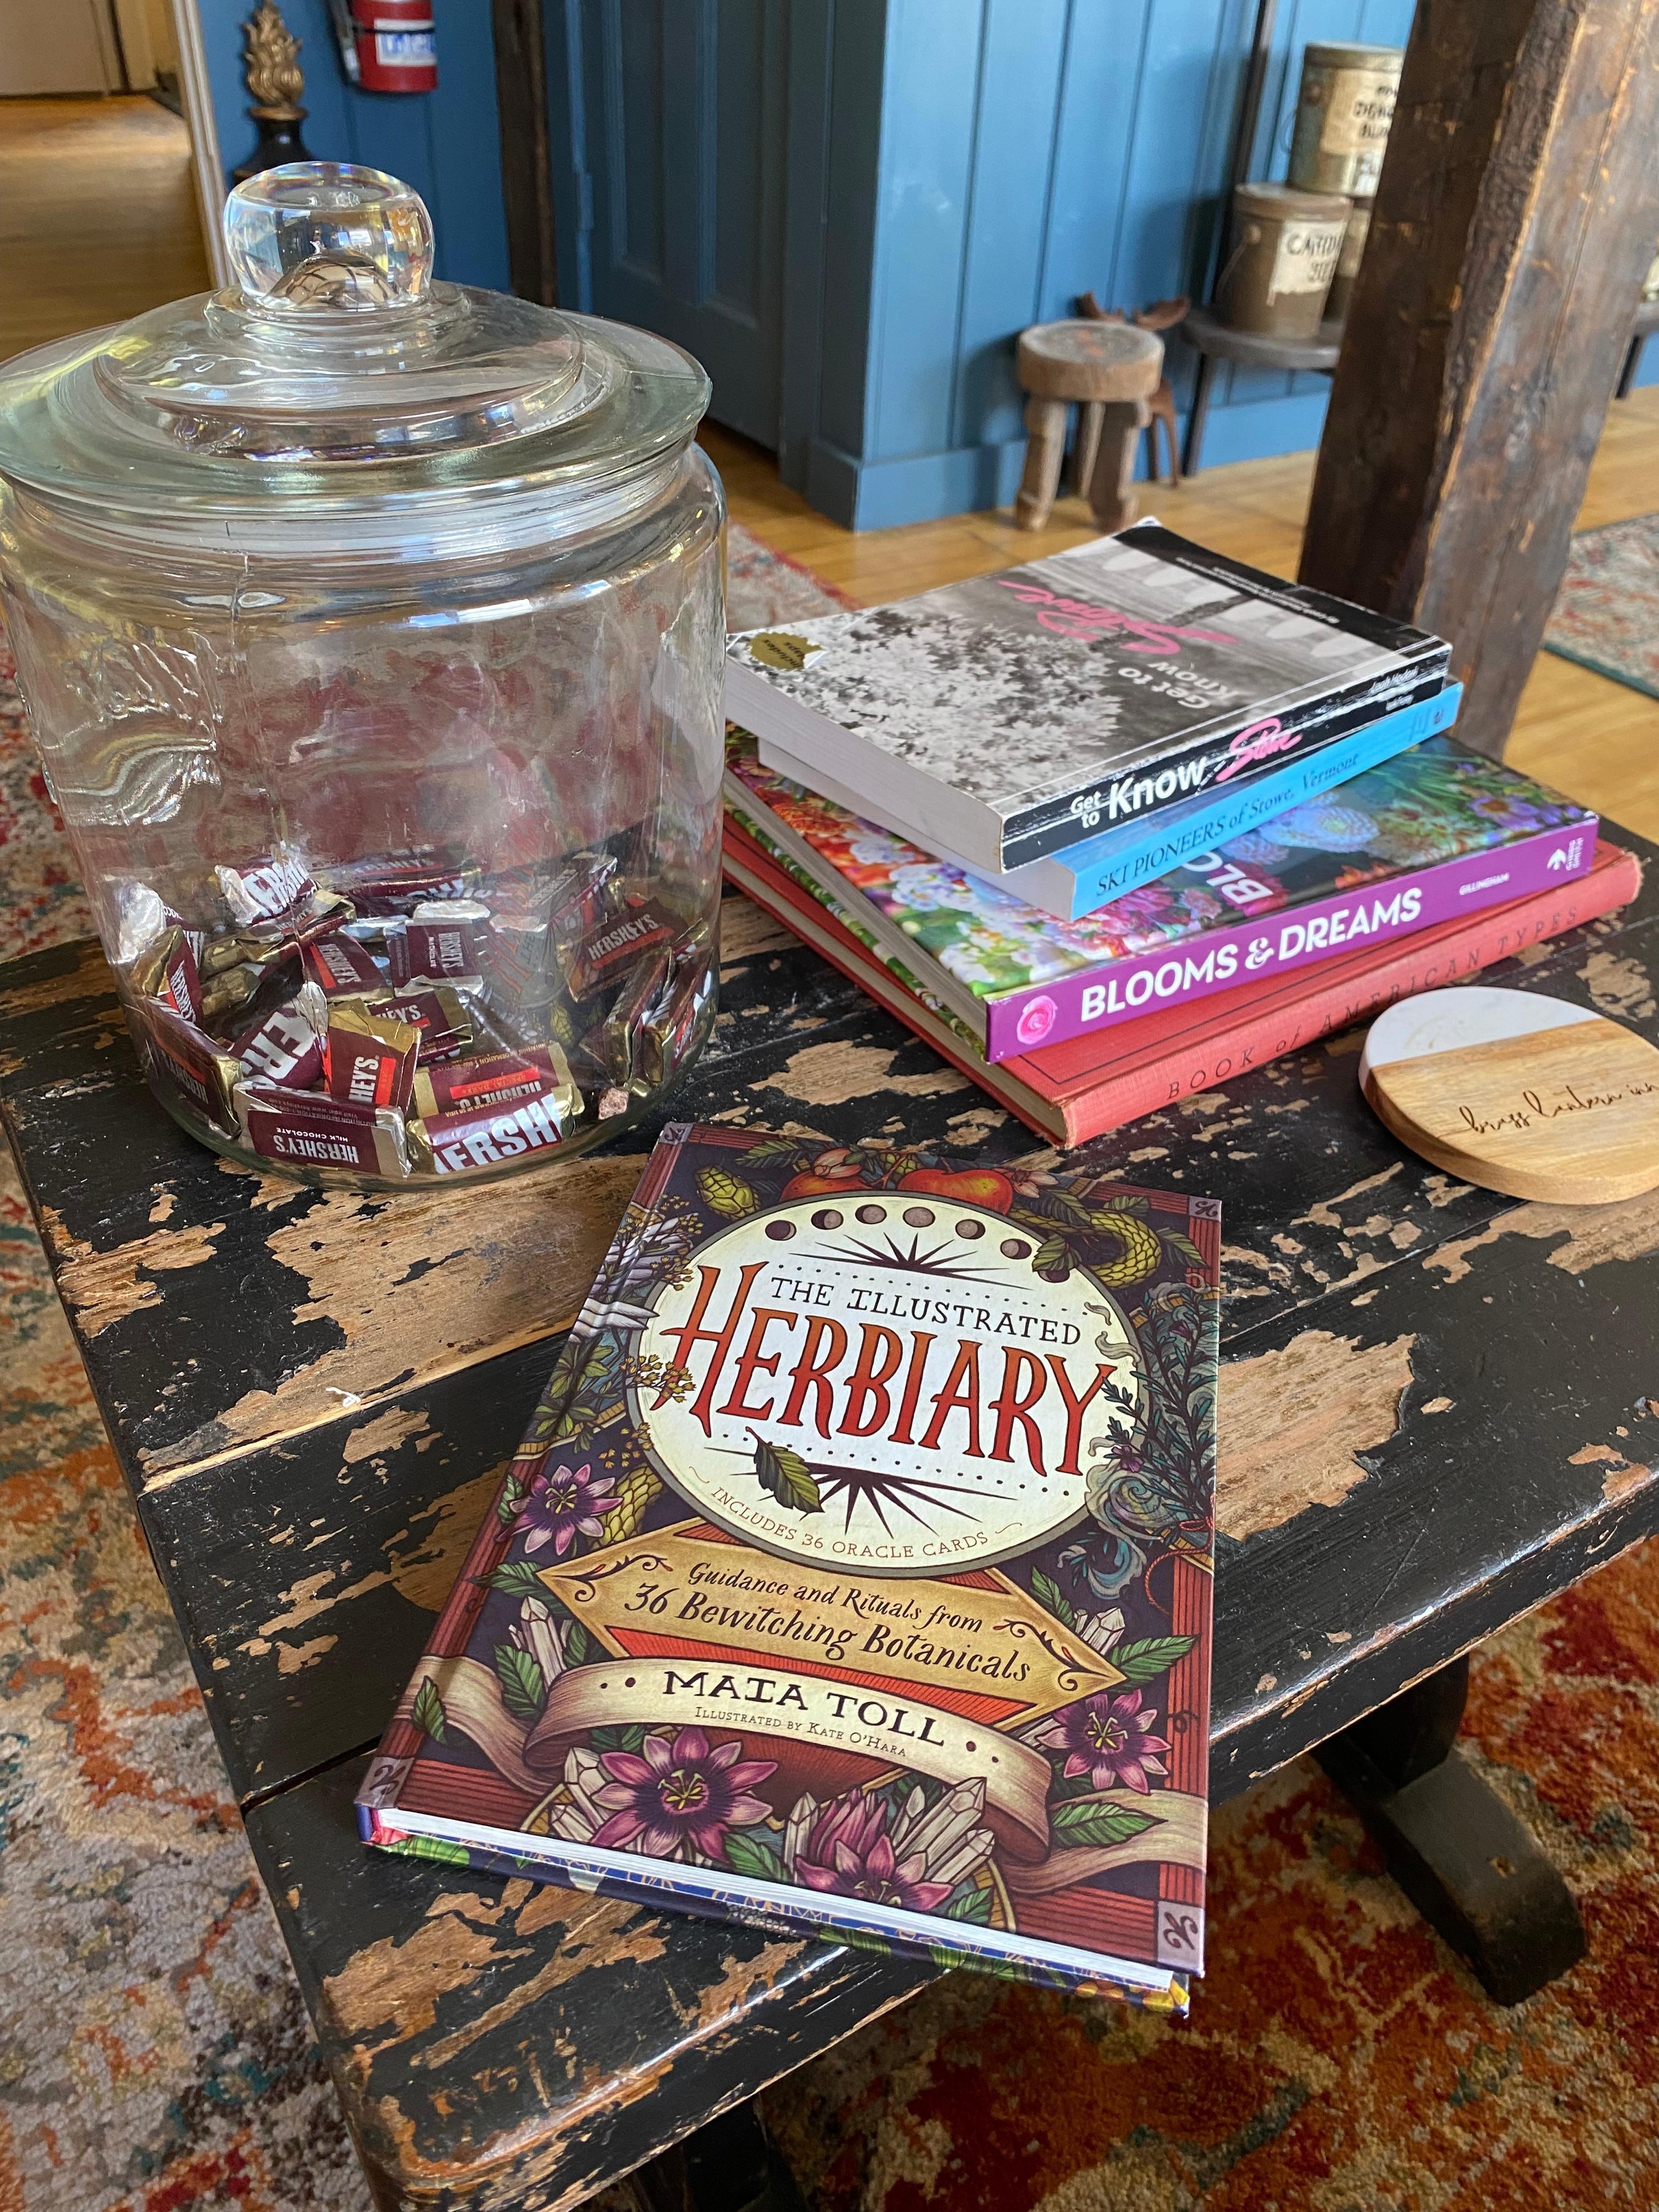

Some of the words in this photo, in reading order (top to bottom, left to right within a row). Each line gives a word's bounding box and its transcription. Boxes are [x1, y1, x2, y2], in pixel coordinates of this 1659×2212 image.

[1118, 667, 1153, 685] to
[1148, 662, 1240, 701] Know
[1152, 681, 1211, 709] Get
[1070, 791, 1102, 814] Get
[1109, 757, 1207, 820] Know
[1081, 810, 1101, 828] to
[1097, 863, 1128, 896] SKI
[1133, 816, 1226, 873] PIONEERS
[1228, 802, 1248, 829] of
[1302, 753, 1361, 791] Vermont
[1182, 852, 1274, 904] BLO
[1459, 872, 1510, 895] GILLINGHAM
[588, 913, 659, 960] HERSHEY'S
[1079, 943, 1239, 1023] BLOOMS
[1244, 934, 1274, 970] &
[1278, 887, 1423, 961] DREAMS
[1167, 1046, 1256, 1099] BOOK
[1276, 1024, 1302, 1052] of
[1319, 947, 1480, 1035] AMERICAN
[1498, 906, 1577, 955] TYPES
[273, 1135, 360, 1164] HERSHEY'S
[276, 1127, 328, 1139] CHOCOLATE
[329, 1135, 348, 1143] MILK
[769, 1276, 834, 1308] THE
[847, 1288, 1082, 1346] ILLUSTRATED
[650, 1261, 1118, 1477] HERBIARY
[710, 1487, 798, 1541] INCLUDES
[800, 1532, 824, 1550] 36
[832, 1540, 915, 1560] ORACLE
[921, 1531, 990, 1558] CARDS
[687, 1562, 789, 1598] Guidance
[793, 1581, 836, 1606] and
[845, 1588, 923, 1622] Rituals
[917, 1604, 984, 1634] from
[624, 1580, 681, 1615] 36
[676, 1587, 859, 1661] Bewitching
[860, 1624, 1031, 1683] Botanicals
[662, 1670, 808, 1711] MAIA
[826, 1691, 946, 1748] TOLL
